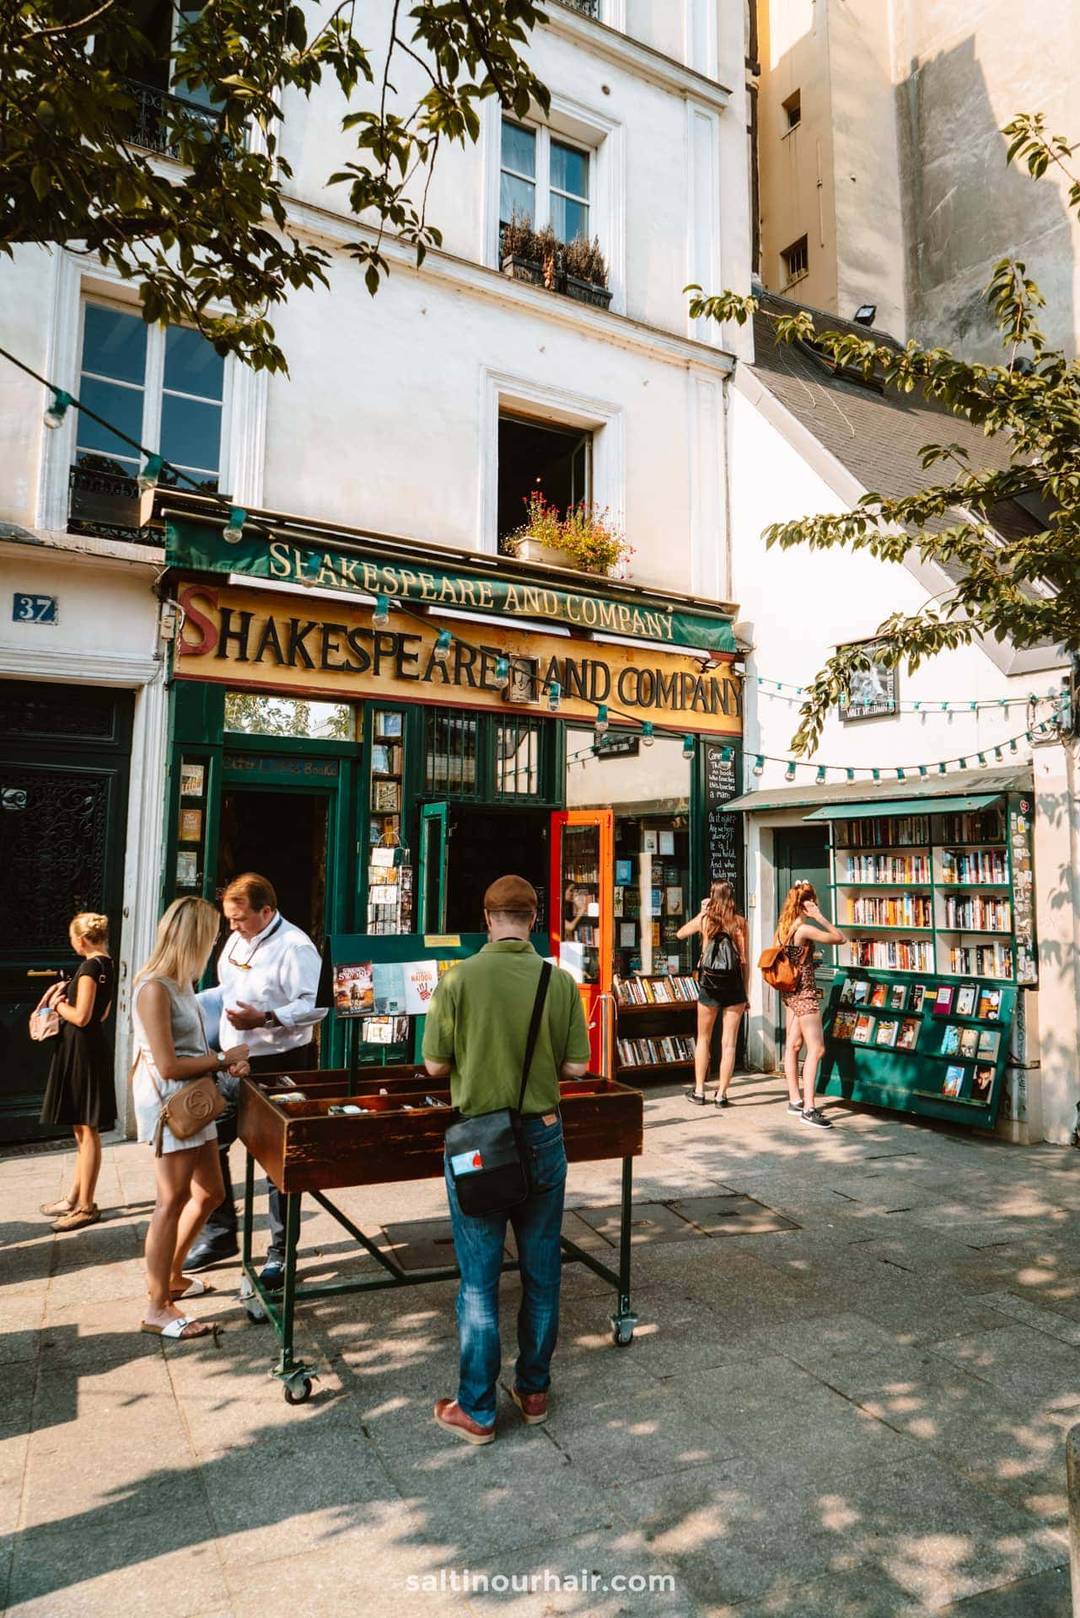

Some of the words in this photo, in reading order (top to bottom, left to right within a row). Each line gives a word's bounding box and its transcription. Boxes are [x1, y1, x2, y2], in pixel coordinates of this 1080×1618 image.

[19, 596, 52, 620] 37
[503, 583, 558, 616] AND
[567, 600, 674, 640] COMPANY
[181, 585, 503, 691] SHAKESPEARE
[544, 655, 611, 702] AND
[617, 666, 743, 717] COMPANY
